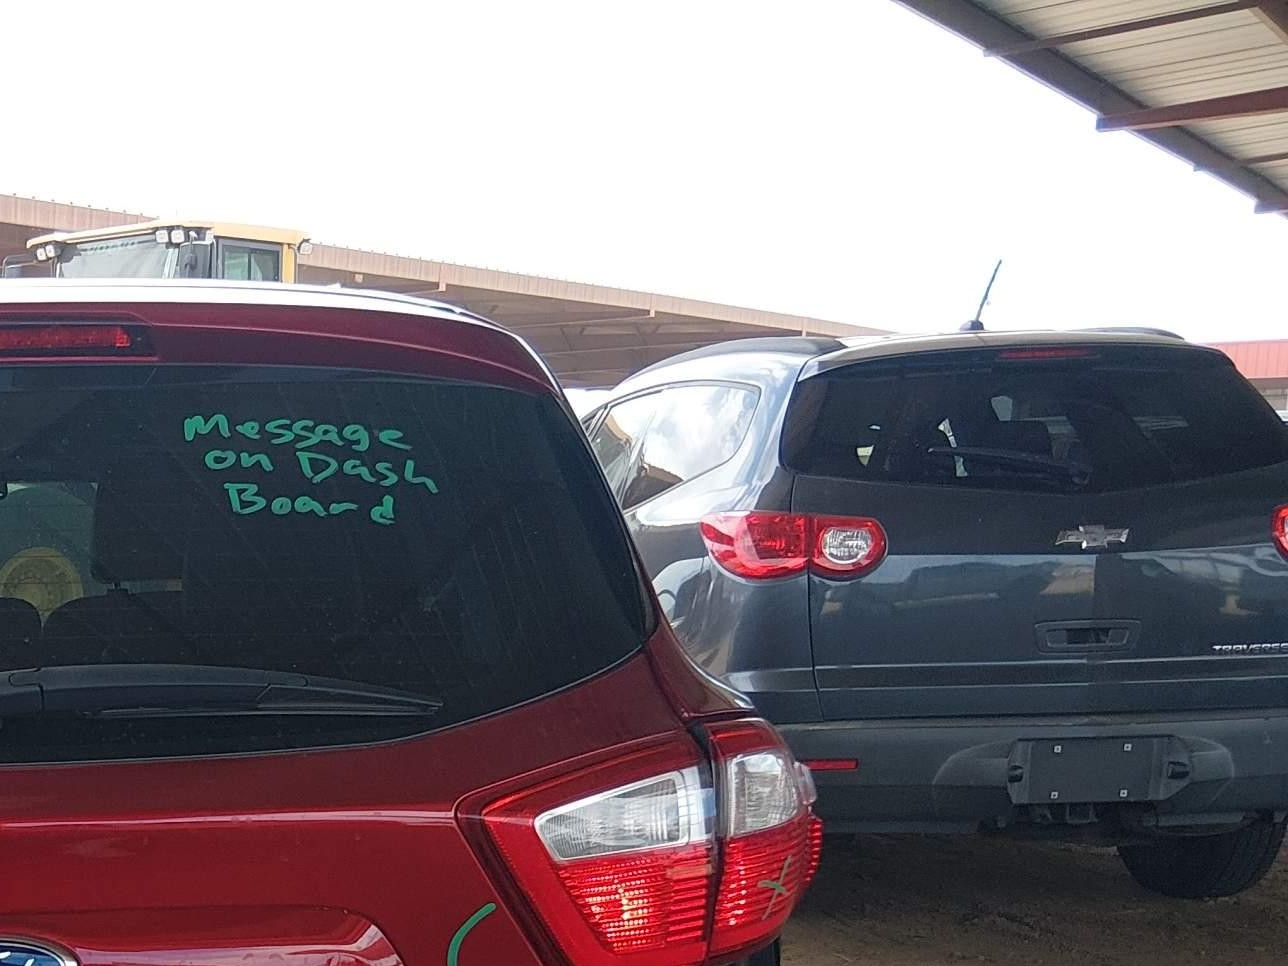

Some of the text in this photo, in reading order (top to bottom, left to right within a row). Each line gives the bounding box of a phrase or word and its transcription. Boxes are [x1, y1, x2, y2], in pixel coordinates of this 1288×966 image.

[183, 414, 412, 451] Message
[204, 450, 439, 493] on Dash
[223, 482, 395, 525] Board
